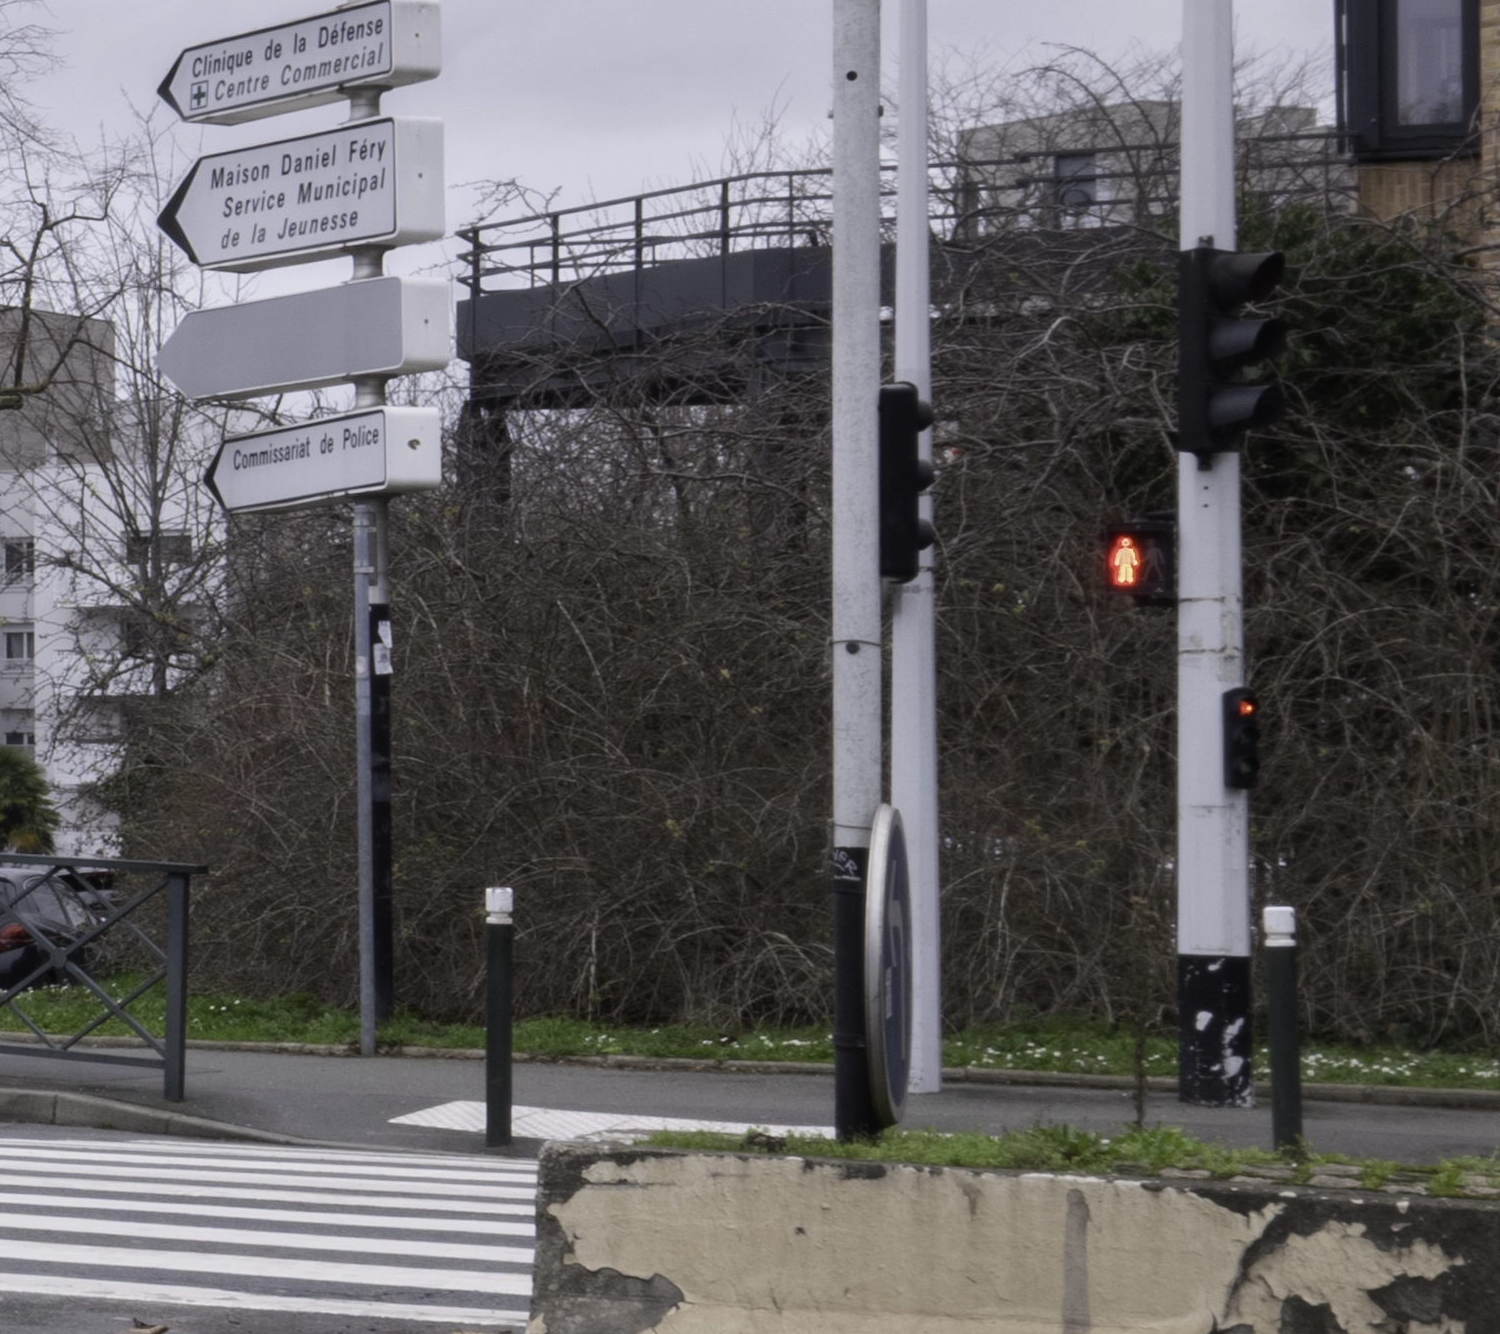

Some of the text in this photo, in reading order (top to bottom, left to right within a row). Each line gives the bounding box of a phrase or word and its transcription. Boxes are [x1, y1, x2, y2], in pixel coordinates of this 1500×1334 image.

[192, 18, 384, 78] Clinique de la Défense
[215, 42, 384, 101] Centre Commercial
[210, 138, 387, 190] Maison Daniel Féry
[222, 167, 386, 218] Service Municipal
[221, 210, 358, 249] de la Jeunesse
[233, 425, 380, 470] Commissariat de Police
